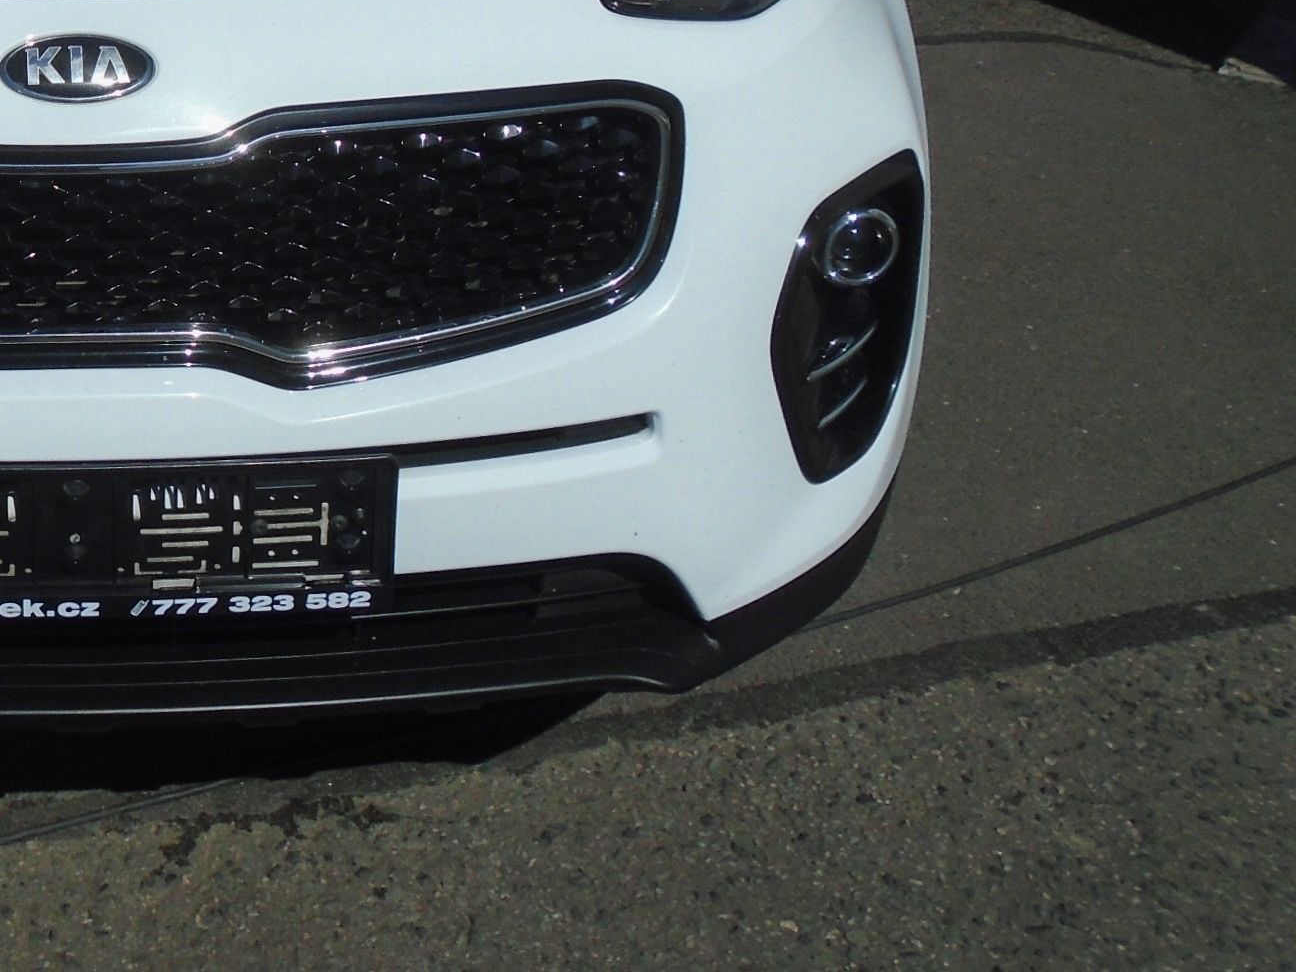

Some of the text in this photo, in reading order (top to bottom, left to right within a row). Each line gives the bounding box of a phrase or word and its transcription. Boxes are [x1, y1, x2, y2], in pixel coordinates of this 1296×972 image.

[25, 45, 131, 86] KIA
[152, 598, 218, 616] 777
[228, 595, 295, 613] 323
[305, 591, 372, 610] 582
